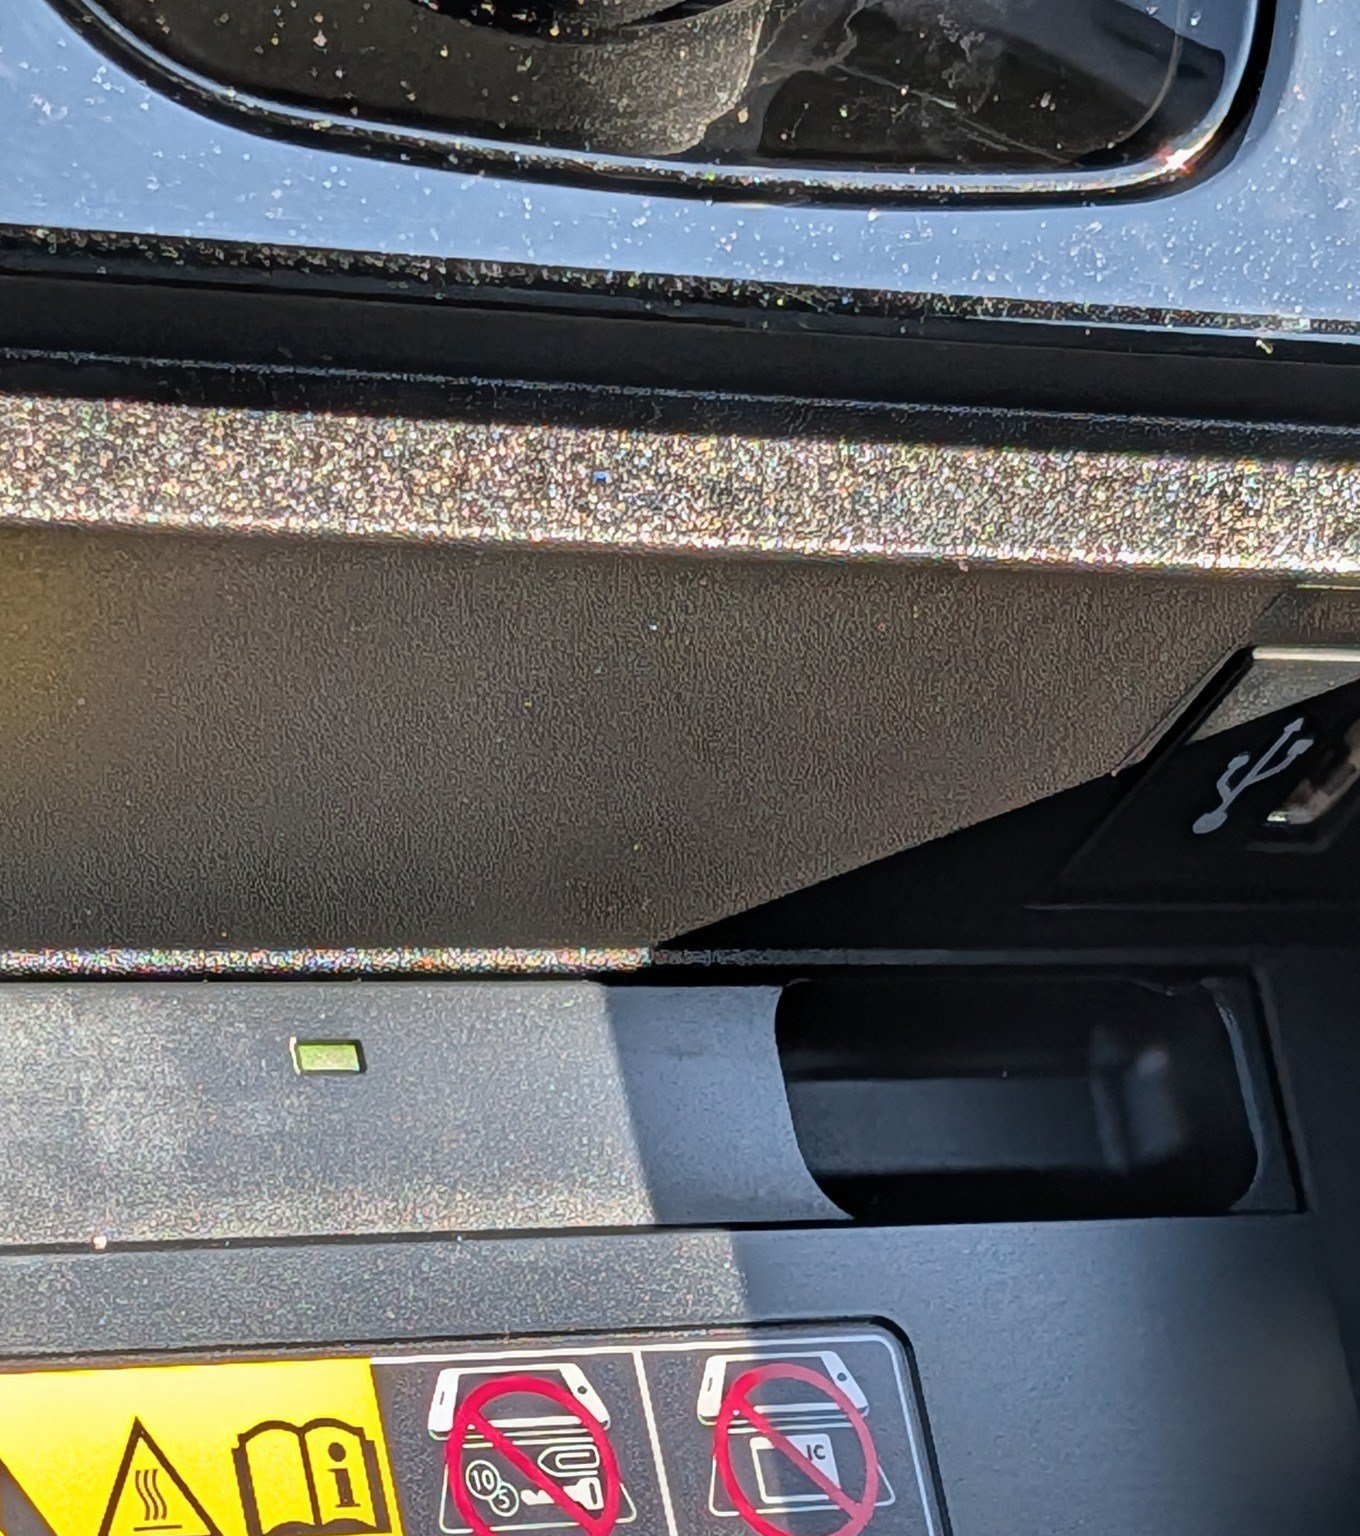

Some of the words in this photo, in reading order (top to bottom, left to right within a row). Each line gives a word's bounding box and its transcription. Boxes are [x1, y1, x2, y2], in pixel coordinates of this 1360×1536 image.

[806, 1444, 826, 1461] IC
[327, 1441, 361, 1508] i
[471, 1470, 495, 1491] 10
[498, 1488, 510, 1508] 5
